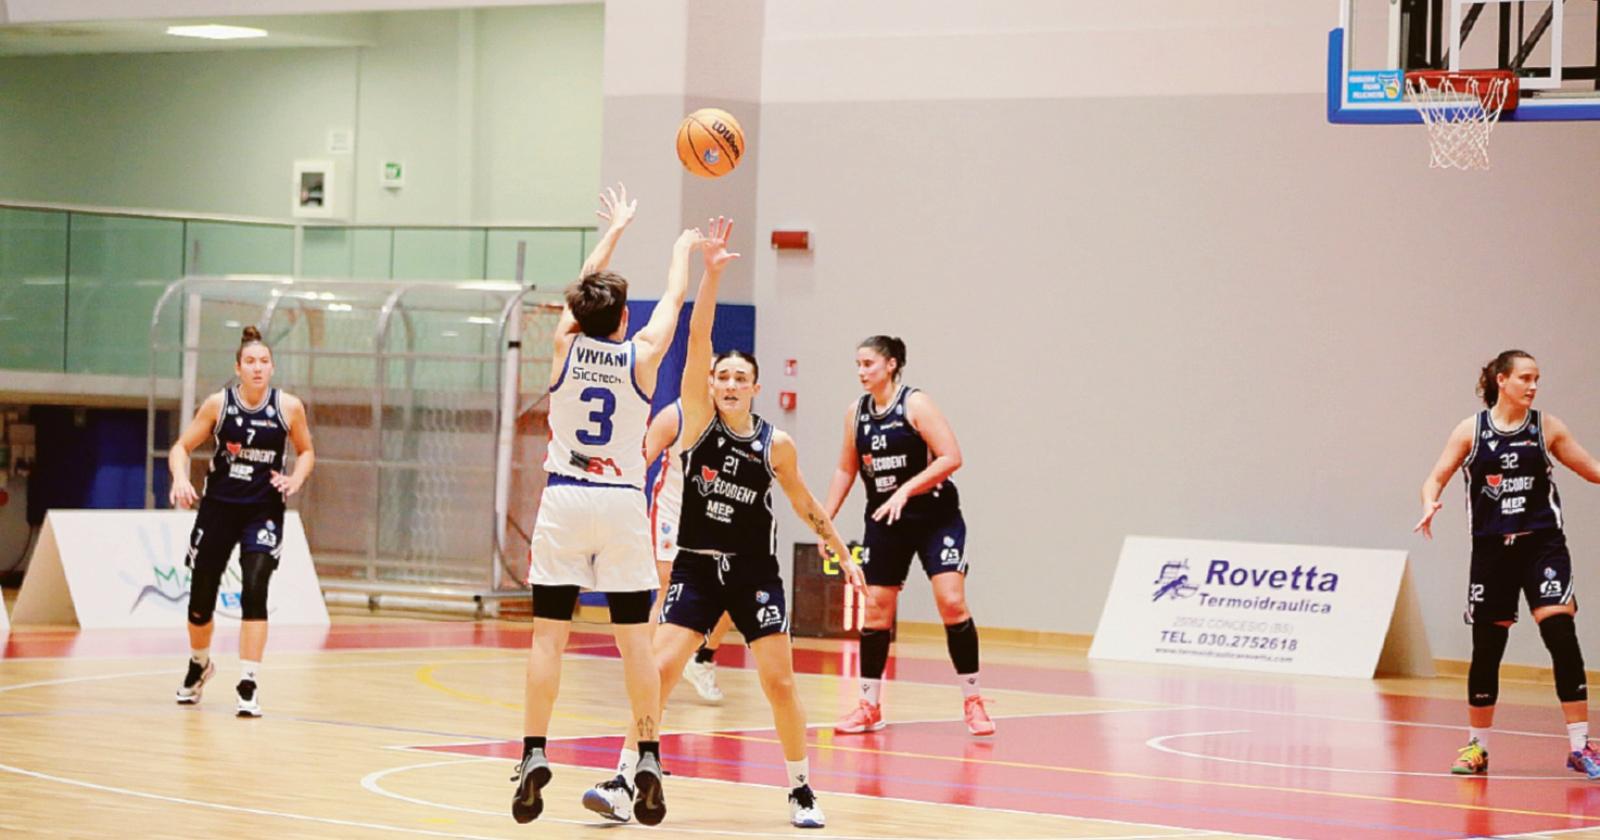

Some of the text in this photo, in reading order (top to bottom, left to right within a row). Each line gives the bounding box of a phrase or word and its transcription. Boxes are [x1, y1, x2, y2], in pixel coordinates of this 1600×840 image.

[576, 346, 627, 367] VIVIANI
[575, 386, 616, 446] 3
[246, 428, 256, 445] 7
[871, 434, 887, 450] 24
[722, 455, 739, 476] 21
[1500, 453, 1519, 469] 32
[714, 477, 757, 505] ECODENT
[706, 500, 735, 516] MEP
[1501, 496, 1526, 508] MEP
[1205, 560, 1339, 592] Rovetta
[667, 583, 684, 601] 21
[1199, 593, 1332, 614] Termoidraulica
[1161, 630, 1298, 652] TEL. 030.2752618
